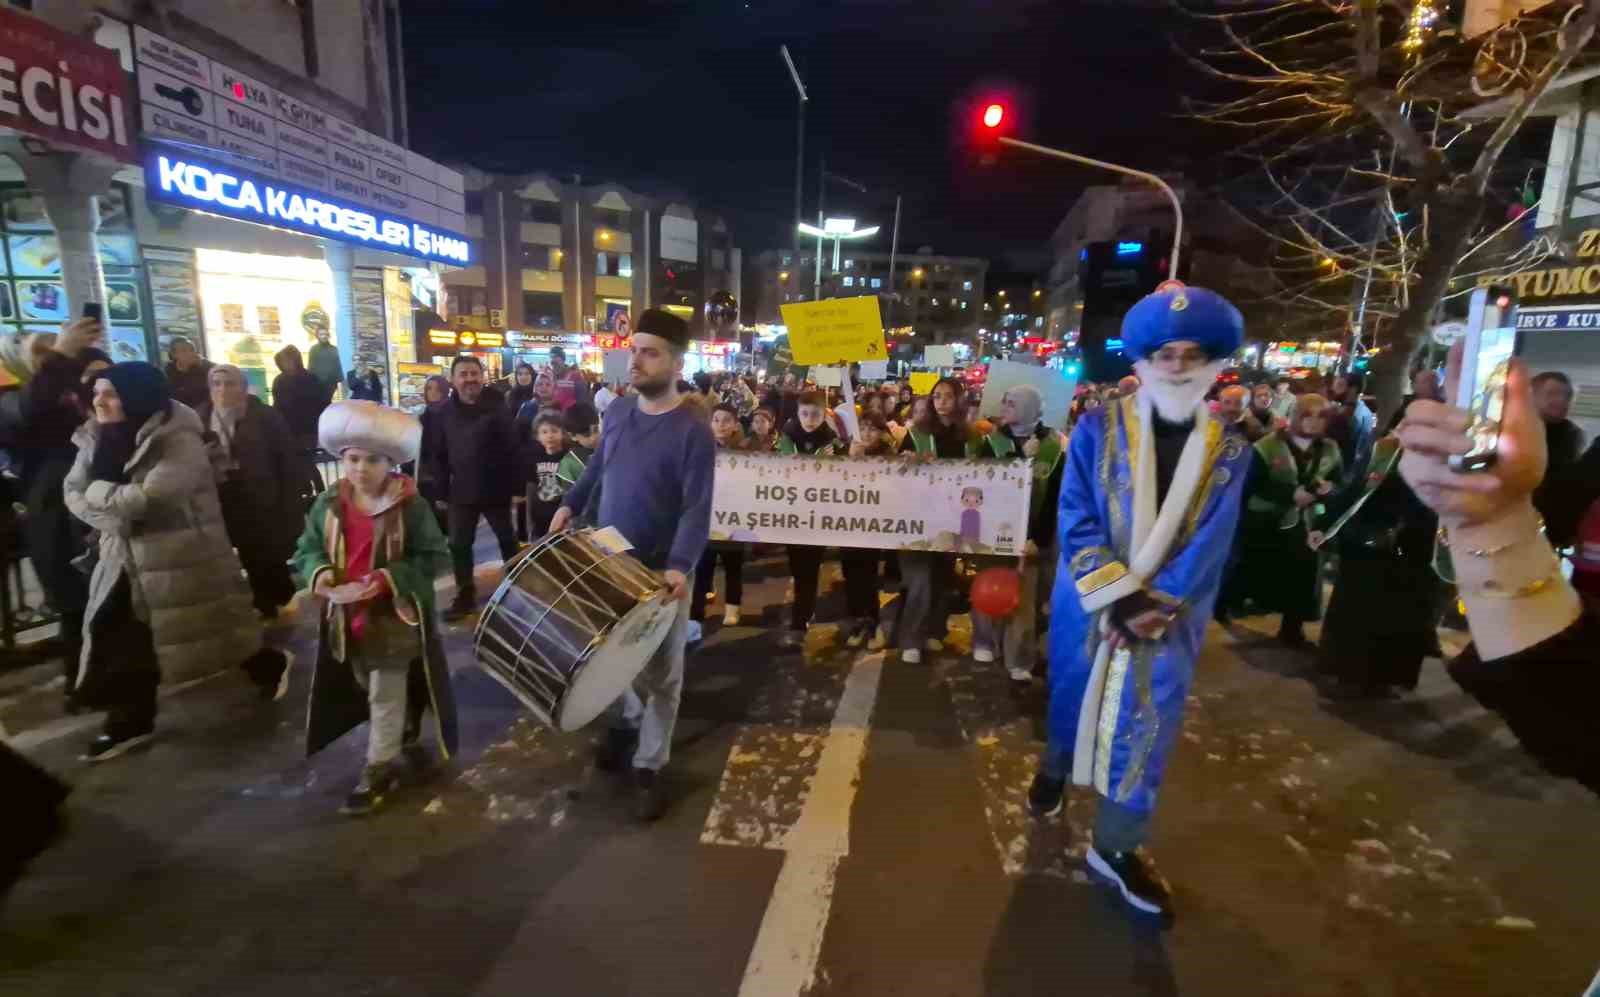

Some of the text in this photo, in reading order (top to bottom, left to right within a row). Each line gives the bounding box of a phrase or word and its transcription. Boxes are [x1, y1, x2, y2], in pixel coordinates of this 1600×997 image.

[158, 156, 264, 213] KOCA
[264, 186, 410, 248] KARDEŞLER
[755, 484, 880, 506] HOŞ GELDİN
[714, 509, 925, 535] YA ŞEHR-İ RAMAZAN
